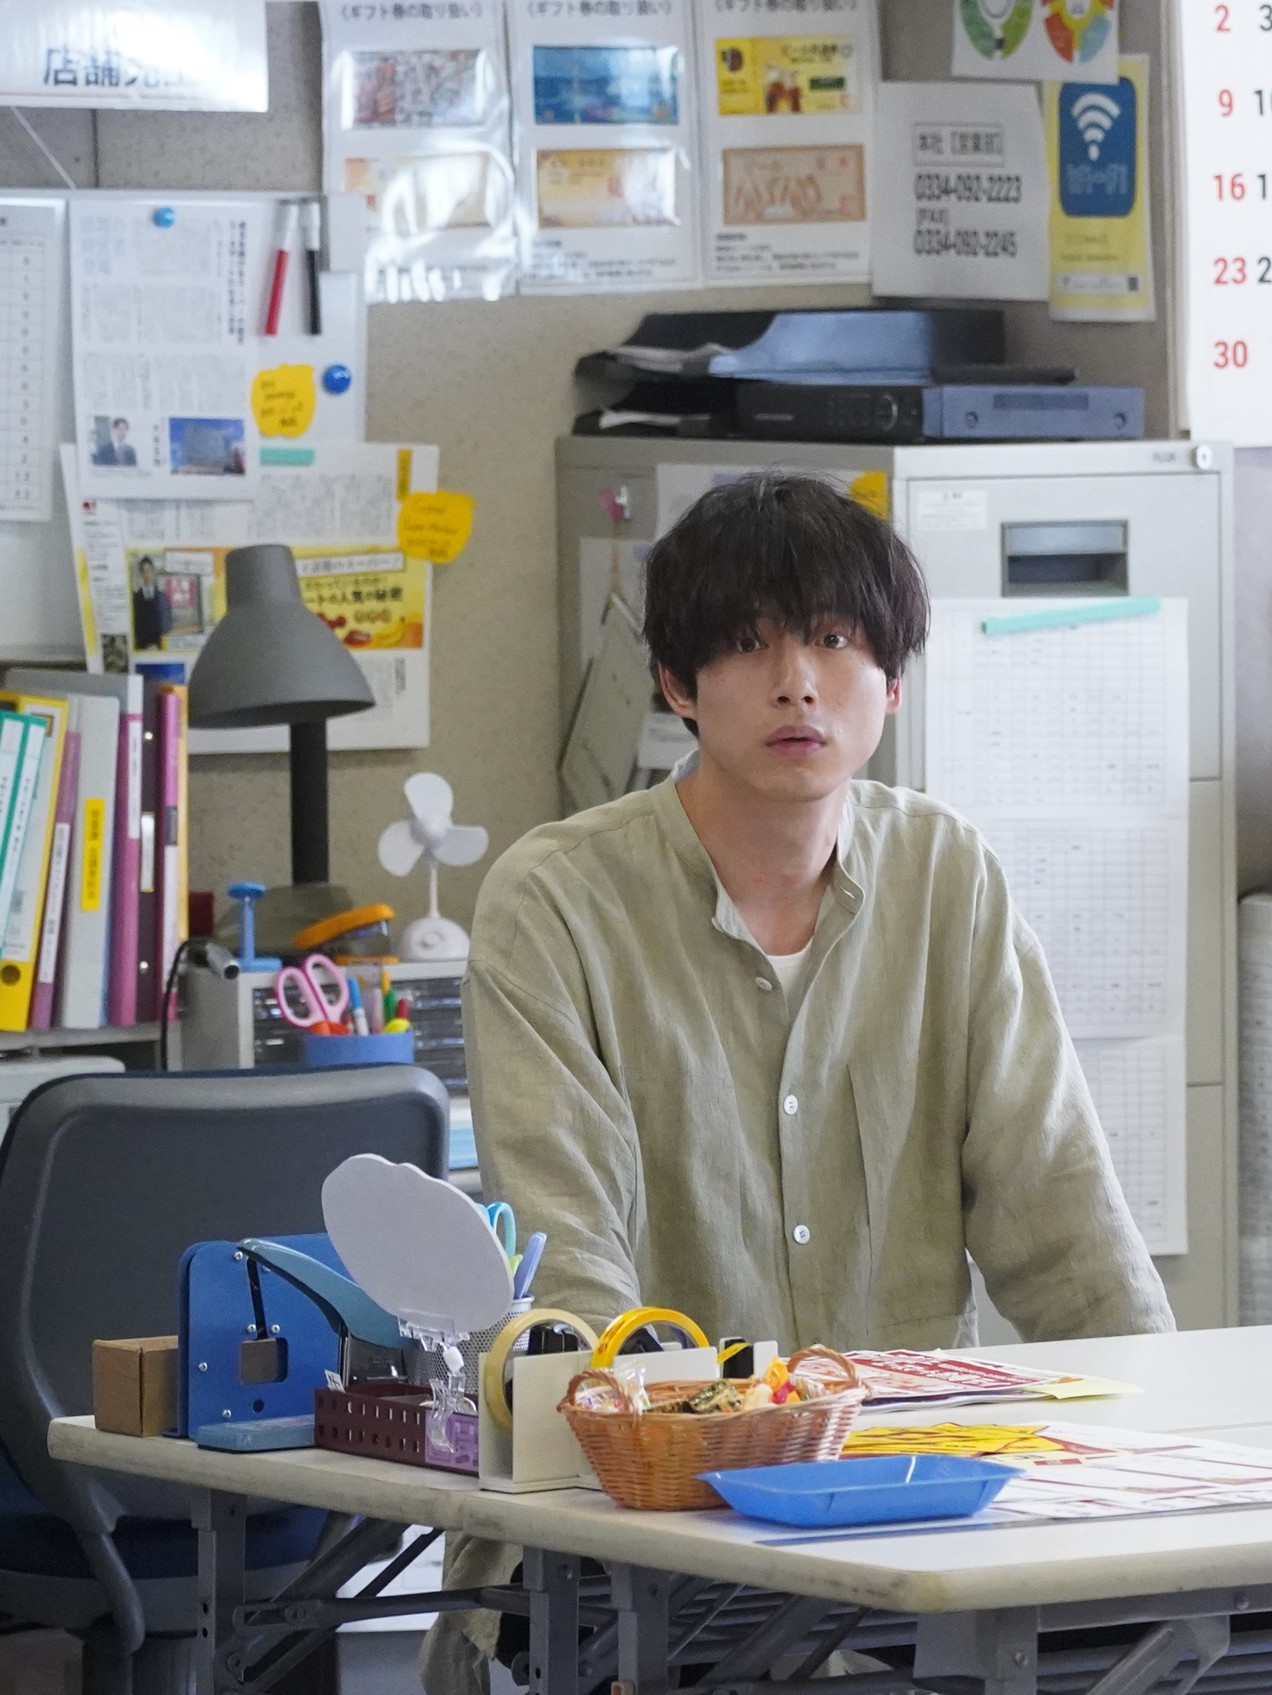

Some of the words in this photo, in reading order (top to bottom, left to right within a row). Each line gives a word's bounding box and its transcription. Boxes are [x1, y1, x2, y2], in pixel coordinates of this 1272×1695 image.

[1215, 4, 1231, 33] 2
[1218, 89, 1234, 117] 9
[1213, 172, 1246, 201] 16
[1213, 256, 1247, 285] 23
[1213, 340, 1248, 369] 30
